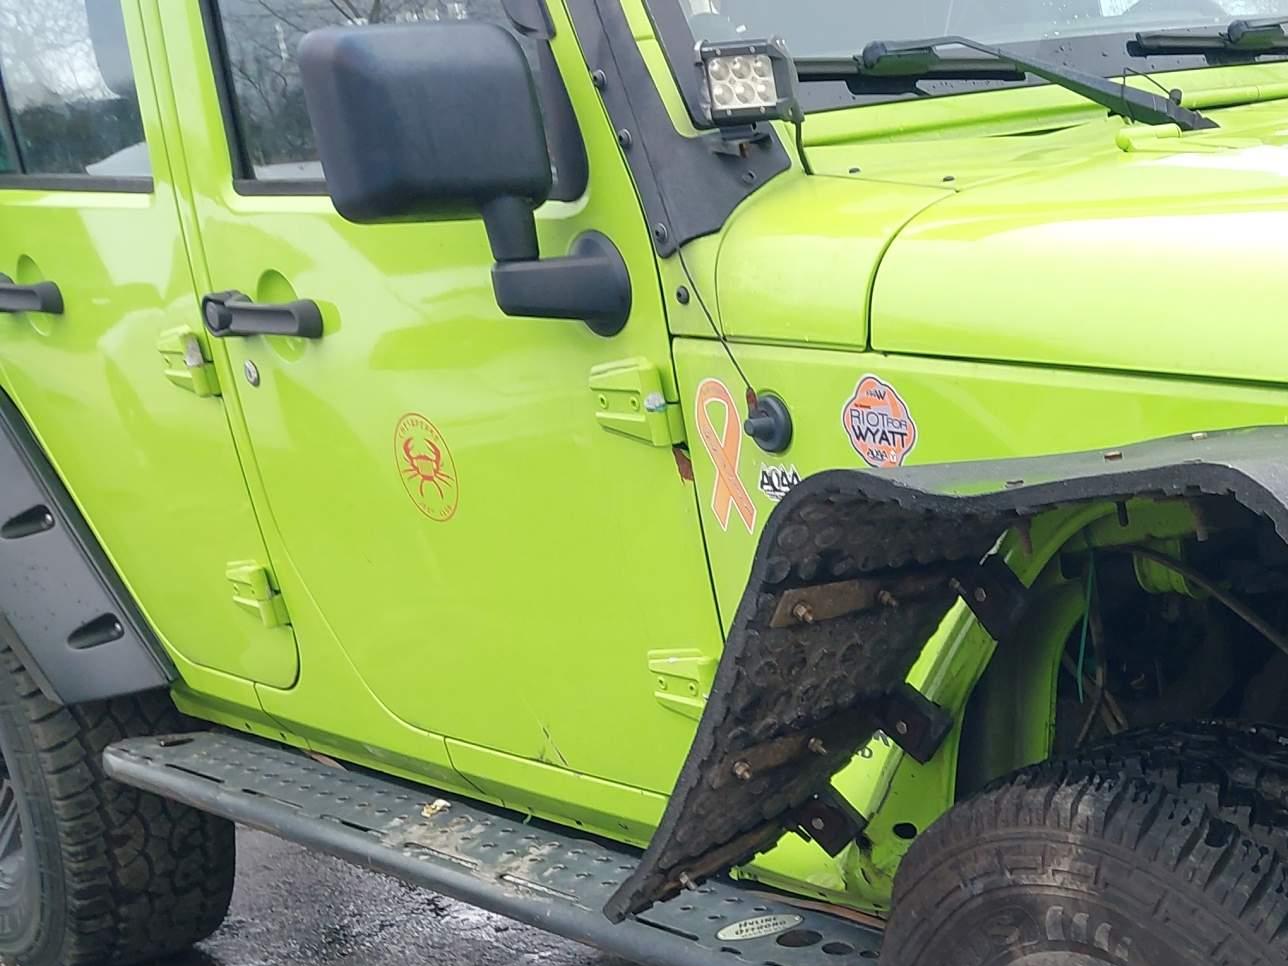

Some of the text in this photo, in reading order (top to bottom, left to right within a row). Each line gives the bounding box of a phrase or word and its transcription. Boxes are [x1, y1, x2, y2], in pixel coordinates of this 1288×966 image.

[849, 408, 908, 431] RIOT FOR
[851, 424, 908, 449] WYATT
